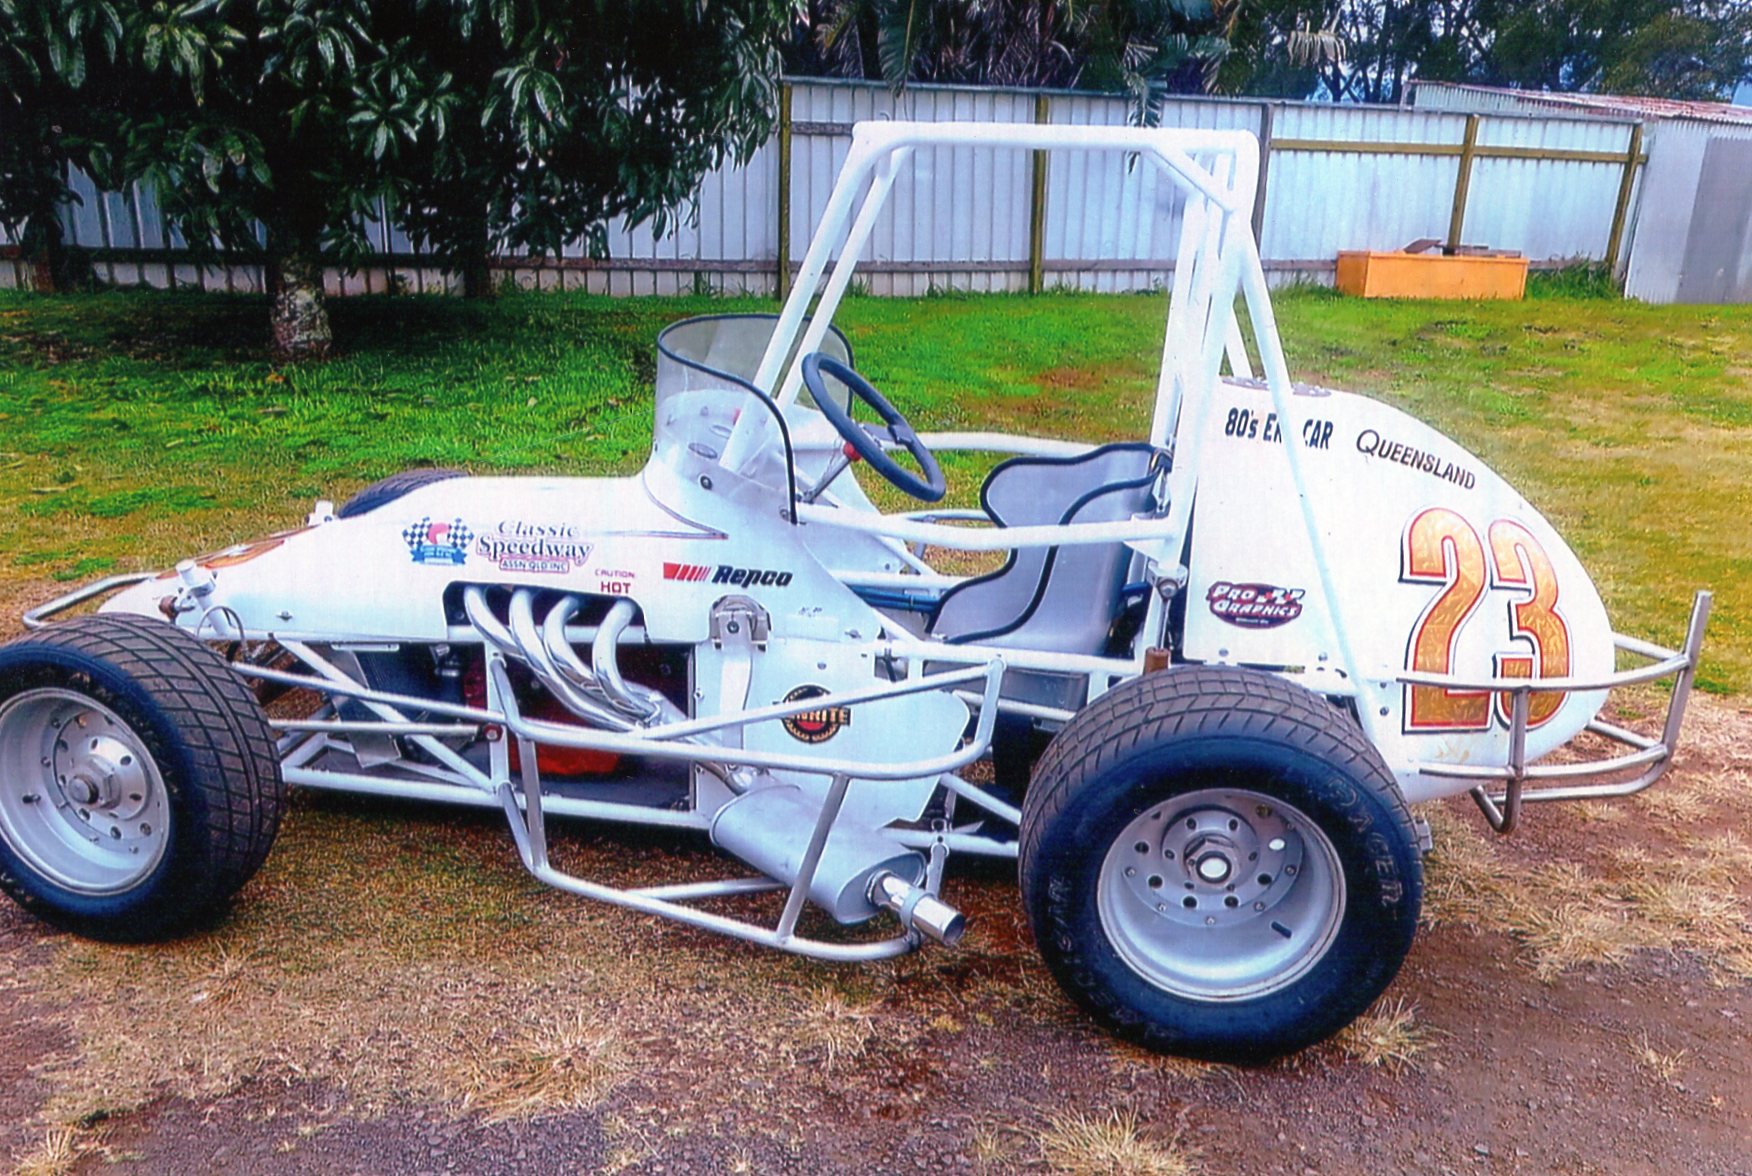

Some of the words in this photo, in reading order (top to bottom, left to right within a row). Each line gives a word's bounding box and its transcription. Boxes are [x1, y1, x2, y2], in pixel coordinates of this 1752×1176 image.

[1224, 407, 1258, 439] 80's
[1303, 419, 1334, 450] CAR
[1356, 429, 1476, 490] QUEENSLAND
[498, 521, 578, 537] Classic
[479, 535, 591, 565] Speedway
[528, 561, 548, 573] QLD
[595, 568, 635, 579] CAUTION
[711, 565, 793, 589] Repco
[600, 581, 632, 594] HOT
[1212, 584, 1257, 601] PRO
[1212, 600, 1299, 617] GRAPHICS
[1399, 507, 1573, 734] 23
